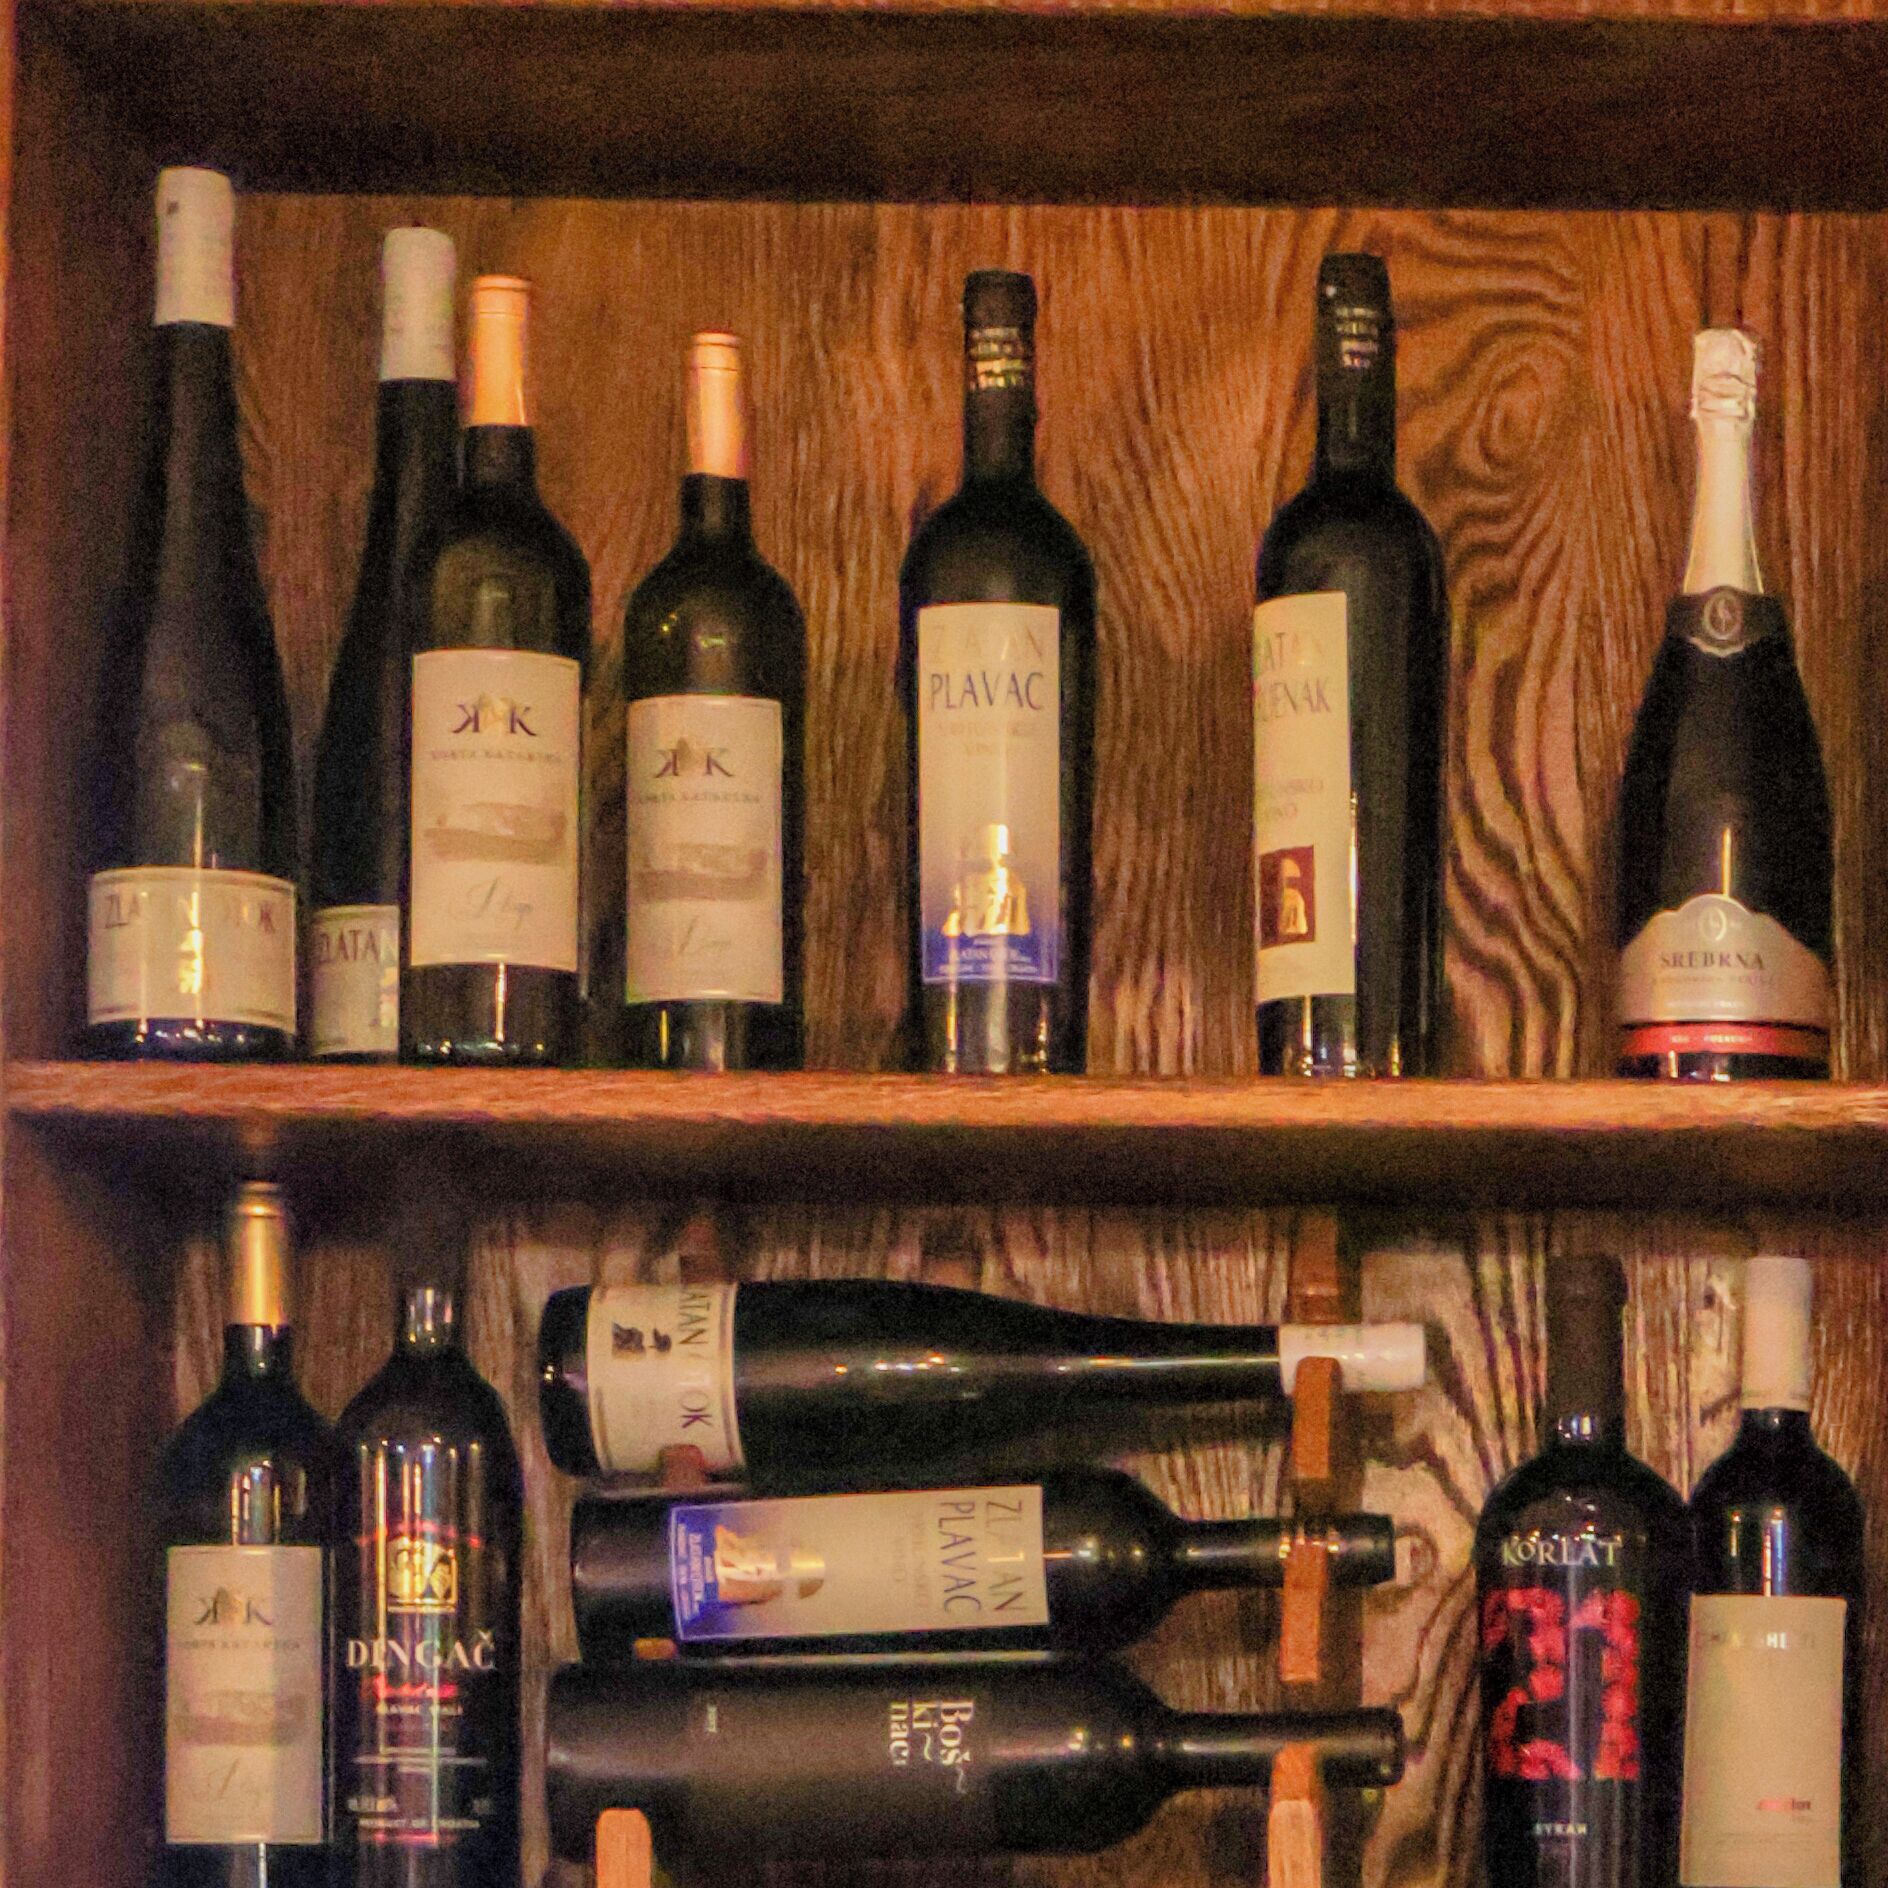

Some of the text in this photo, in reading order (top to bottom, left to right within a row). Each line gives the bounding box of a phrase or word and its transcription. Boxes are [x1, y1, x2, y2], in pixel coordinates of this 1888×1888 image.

[928, 671, 1044, 712] PLAVAC
[1660, 950, 1766, 971] SREBRNA
[937, 1500, 982, 1612] PLAVAC
[1502, 1538, 1618, 1567] KORLAT
[347, 1628, 498, 1671] DINGAČ
